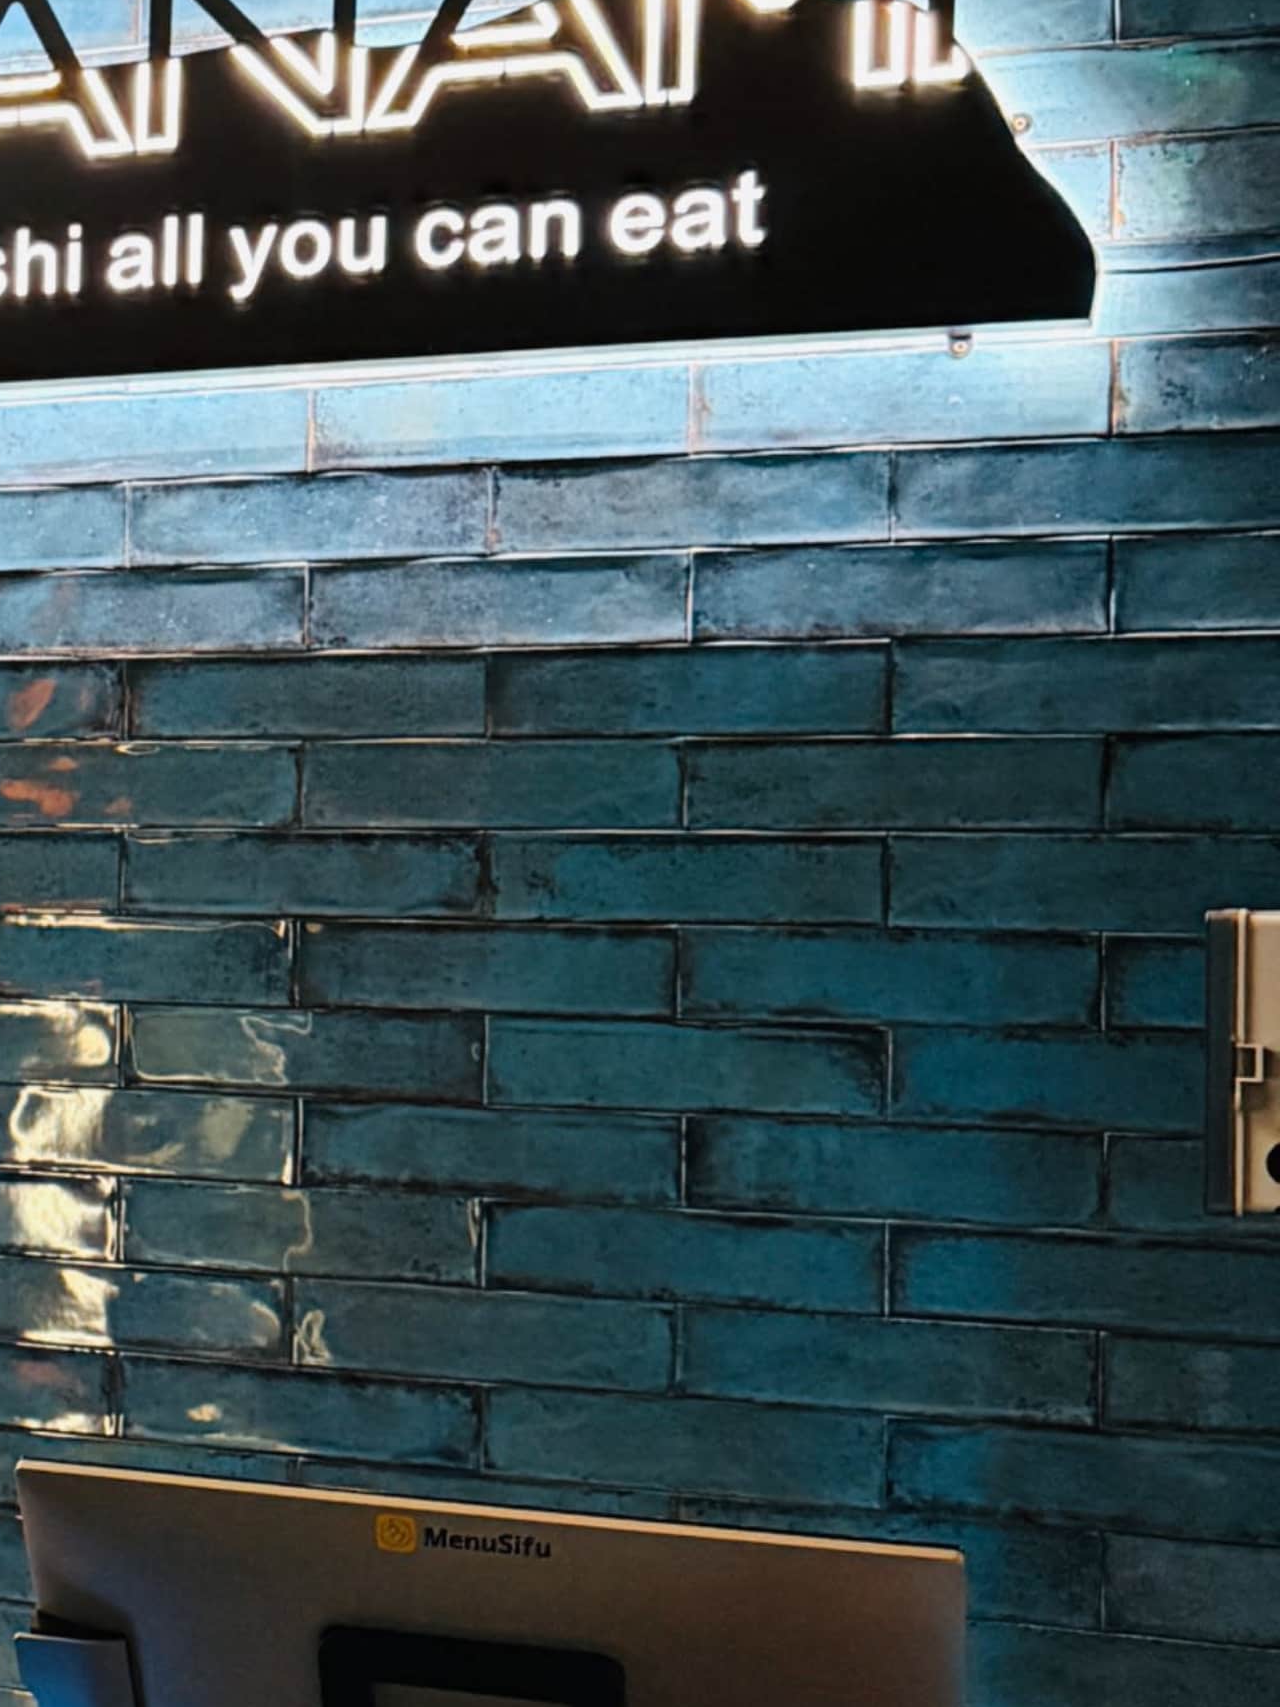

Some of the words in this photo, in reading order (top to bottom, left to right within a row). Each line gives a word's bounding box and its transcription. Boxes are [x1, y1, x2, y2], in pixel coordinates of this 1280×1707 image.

[105, 212, 205, 294] all
[228, 214, 388, 303] you
[414, 202, 582, 269] can
[608, 169, 768, 254] eat
[423, 1525, 552, 1558] MenuSifu
